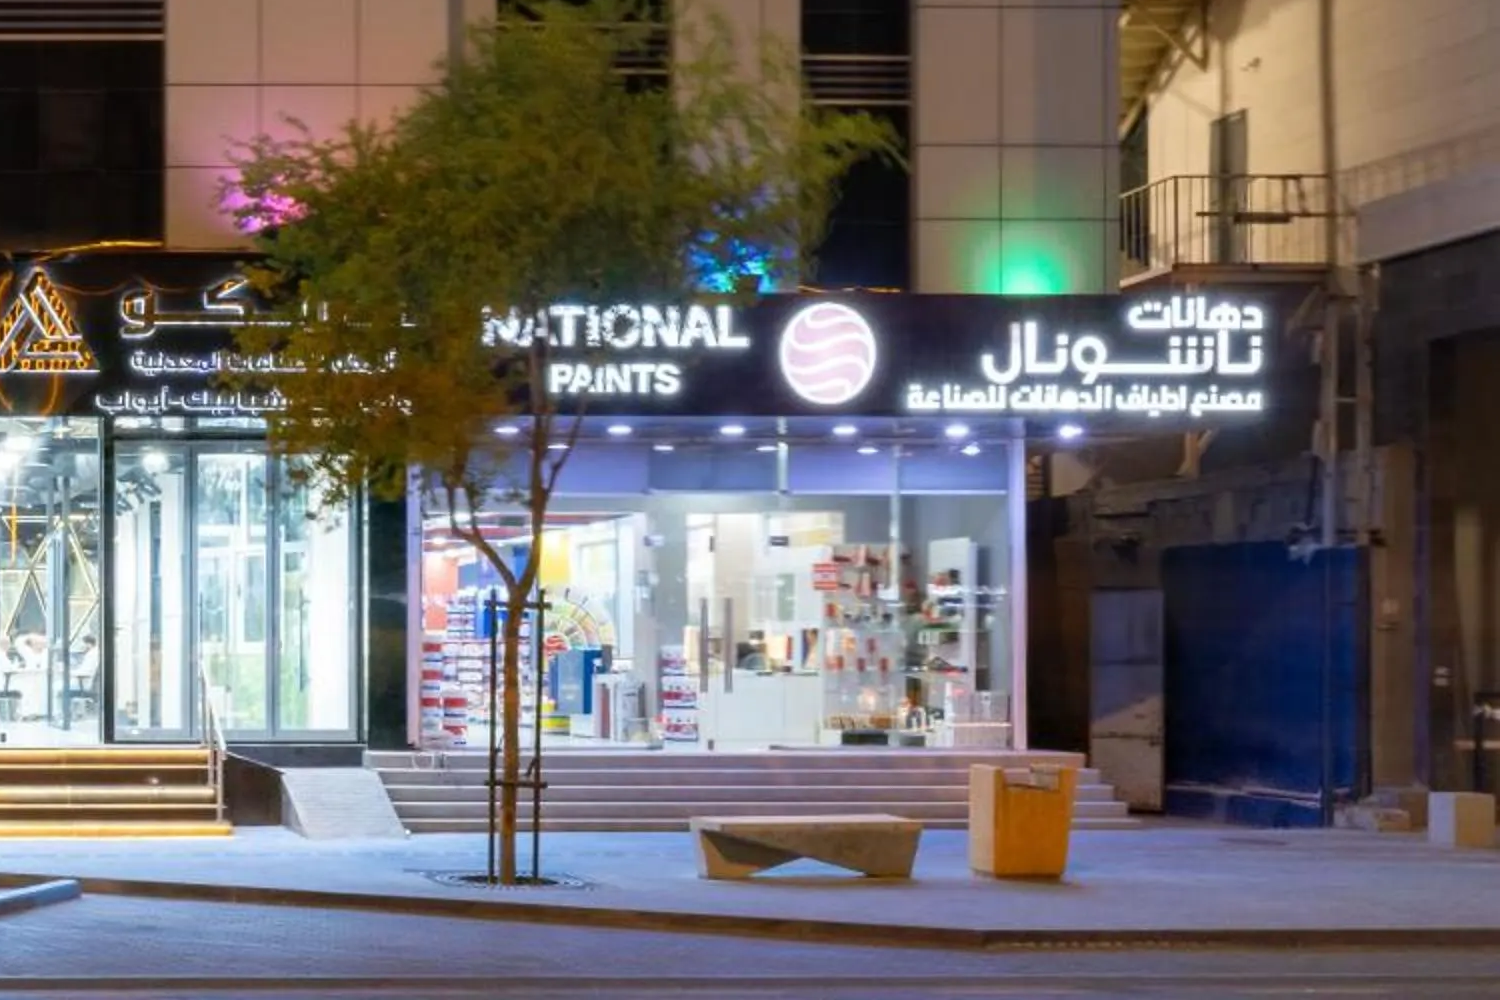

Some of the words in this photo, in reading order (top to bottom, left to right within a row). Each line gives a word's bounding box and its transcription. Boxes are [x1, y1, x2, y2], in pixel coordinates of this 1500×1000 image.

[481, 303, 752, 350] NATIONAL
[1127, 295, 1264, 330] دهانات
[547, 362, 682, 396] PAINTS
[1187, 385, 1264, 417] مصنع
